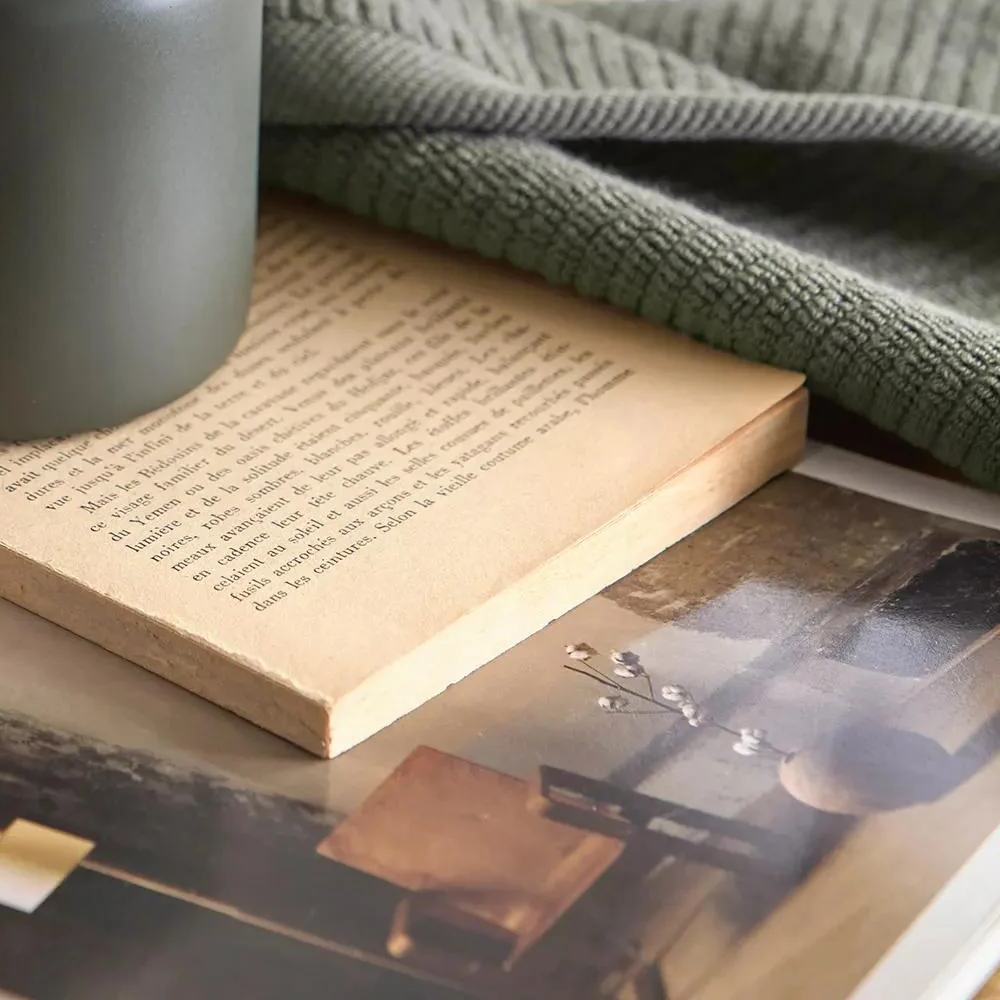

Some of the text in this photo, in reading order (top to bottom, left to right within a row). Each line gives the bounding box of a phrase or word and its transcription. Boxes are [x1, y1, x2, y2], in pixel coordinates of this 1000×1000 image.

[4, 471, 41, 493] avait
[41, 436, 91, 471] quelque
[24, 479, 65, 501] dures
[68, 467, 84, 477] et
[81, 456, 103, 466] la
[106, 436, 134, 454] mer
[45, 495, 69, 510] vue
[71, 463, 126, 495] jusqu'à
[121, 433, 173, 463] l'infini
[175, 422, 191, 433] de
[192, 411, 213, 421] la
[79, 493, 117, 514] Mais
[114, 479, 141, 492] les
[203, 429, 222, 441] de
[218, 420, 240, 429] la
[89, 521, 107, 532] ce
[110, 493, 154, 518] visage
[153, 458, 210, 491] familier
[213, 444, 235, 456] du
[108, 529, 131, 542] du
[184, 484, 205, 496] ou
[206, 468, 232, 482] des
[235, 445, 270, 465] oasis
[124, 520, 182, 552] lumière
[184, 508, 200, 518] et
[201, 495, 221, 507] de
[217, 485, 240, 494] la
[242, 451, 291, 484] solitude
[149, 535, 199, 562] noires,
[200, 506, 241, 530] robes
[170, 543, 217, 572] meaux
[219, 497, 290, 542] avançaient
[290, 484, 309, 495] de
[308, 465, 342, 483] leur
[345, 449, 370, 466] pas
[192, 570, 211, 581] en
[217, 532, 270, 565] cadence
[270, 510, 303, 529] leur
[307, 491, 336, 508] tête
[341, 460, 392, 488] chauve.
[213, 557, 265, 591] celaient
[266, 545, 286, 557] au
[287, 518, 324, 544] soleil
[326, 510, 342, 520] et
[343, 486, 379, 510] aussi
[374, 475, 400, 487] les
[229, 578, 271, 602] fusils
[272, 536, 336, 577] accrochés
[338, 518, 365, 535] aux
[367, 490, 412, 518] arçons
[412, 479, 428, 489] et
[424, 467, 450, 479] les
[252, 590, 288, 611] dans
[284, 575, 311, 589] les
[312, 536, 377, 574] ceintures.
[373, 509, 417, 533] Selon
[413, 498, 435, 508] la
[435, 472, 477, 496] vieille
[479, 435, 534, 471] coutume
